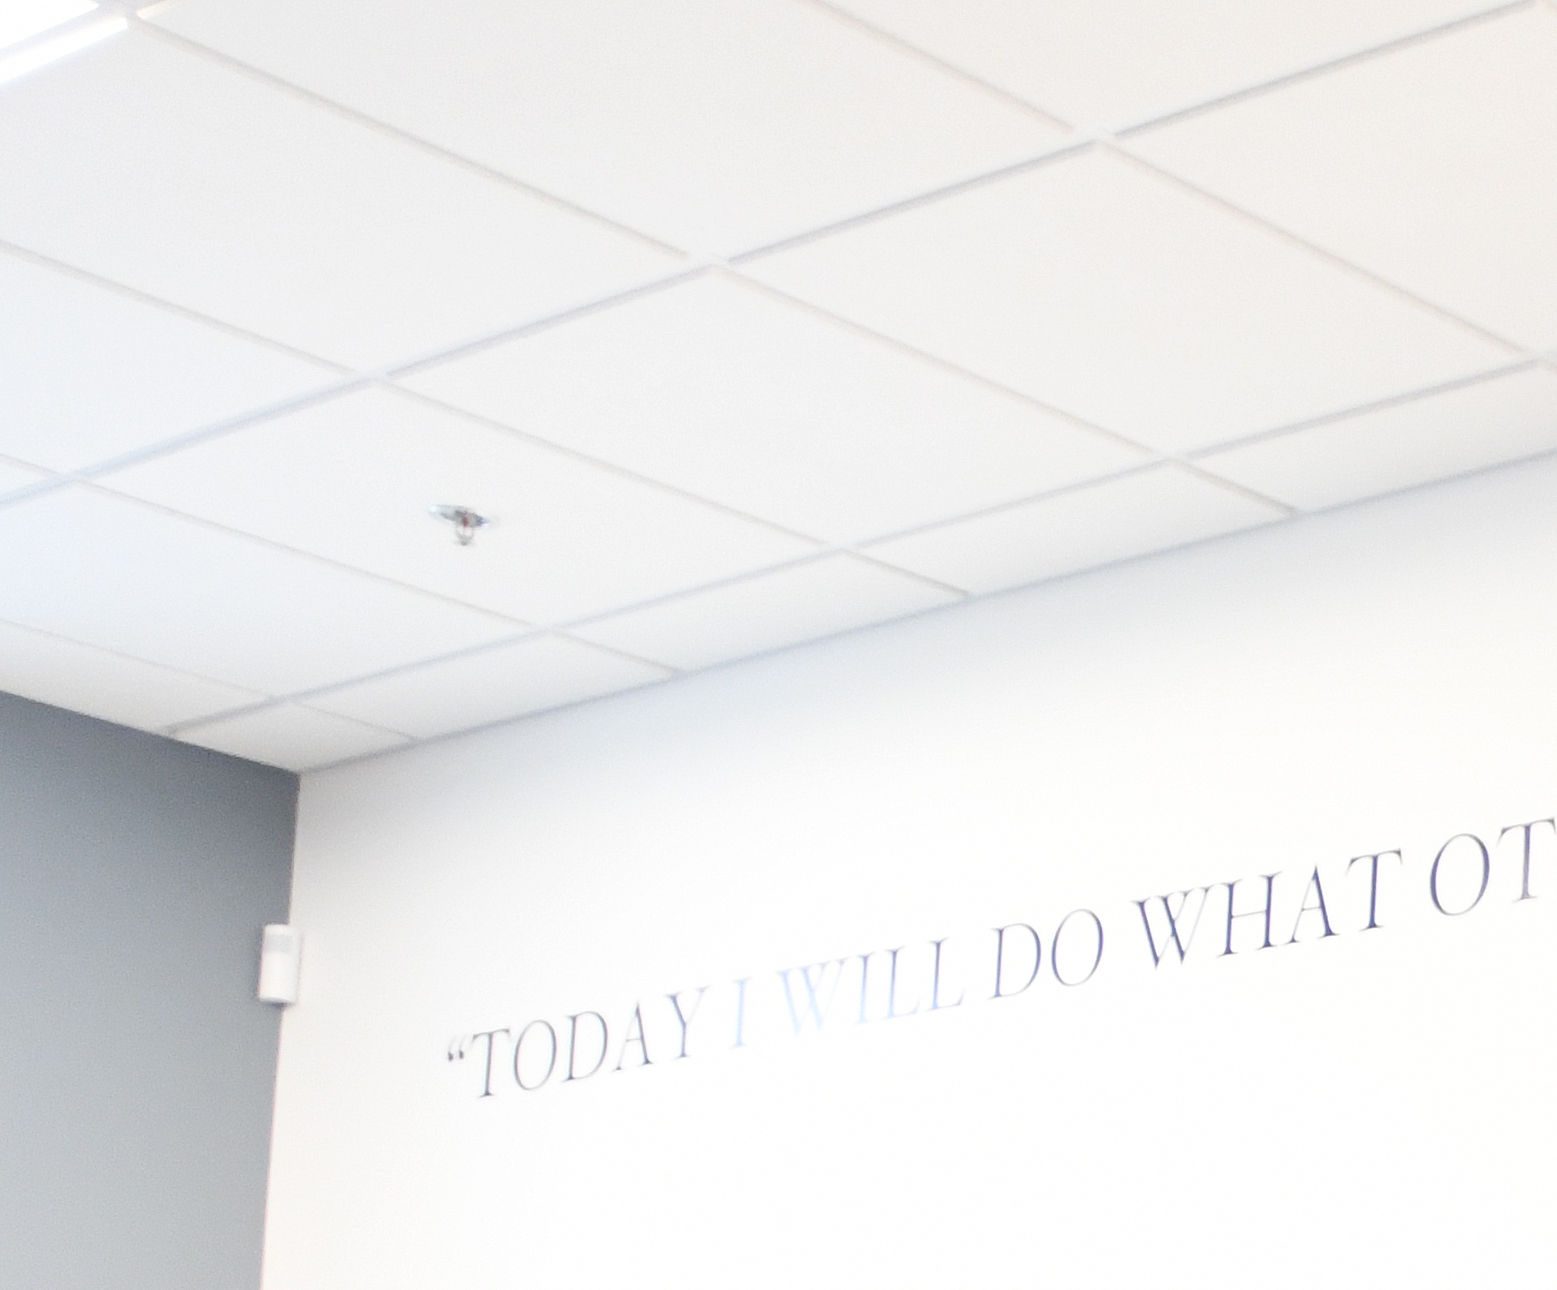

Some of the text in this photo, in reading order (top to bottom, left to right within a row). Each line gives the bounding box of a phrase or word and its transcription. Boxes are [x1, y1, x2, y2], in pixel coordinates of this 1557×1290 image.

[725, 978, 751, 1050] I
[777, 937, 963, 1041] WILL
[990, 907, 1107, 1001] DO
[1131, 846, 1404, 970] WHAT
